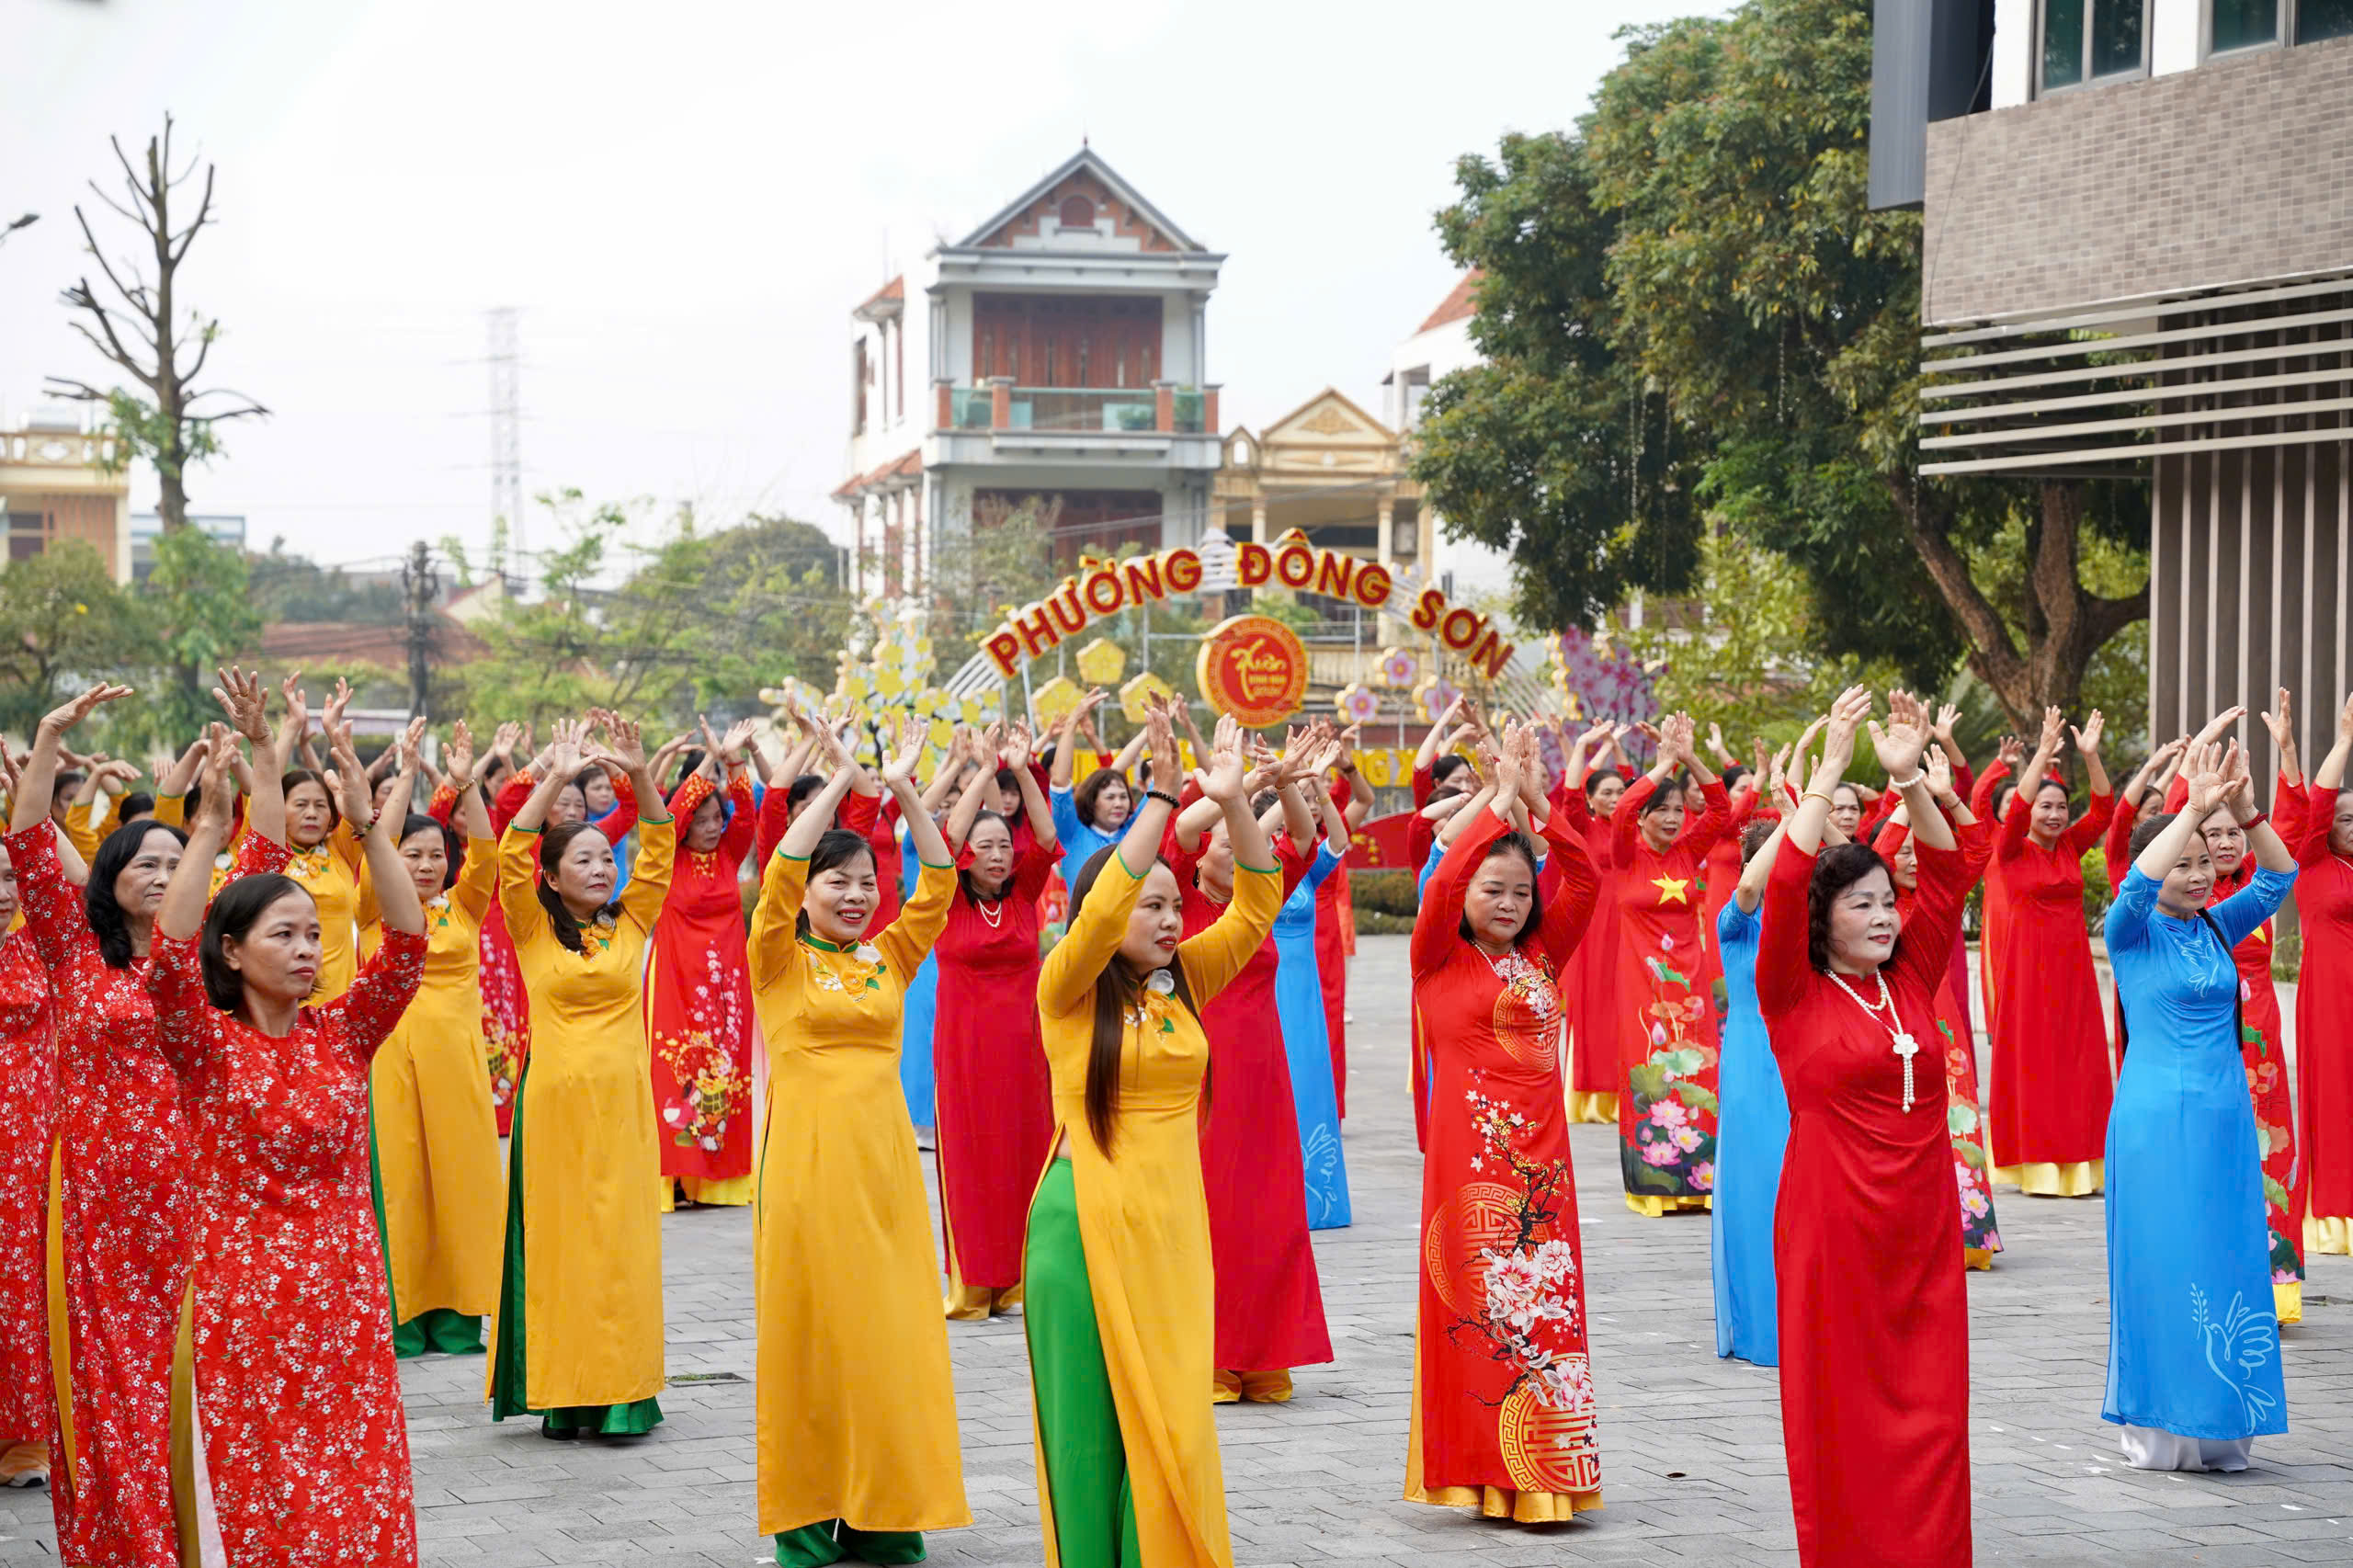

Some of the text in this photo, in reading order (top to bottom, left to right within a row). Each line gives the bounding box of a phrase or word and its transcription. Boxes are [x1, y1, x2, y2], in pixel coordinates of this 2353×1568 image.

[985, 528, 1515, 679] PHƯỜNG ĐÔNG SƠN
